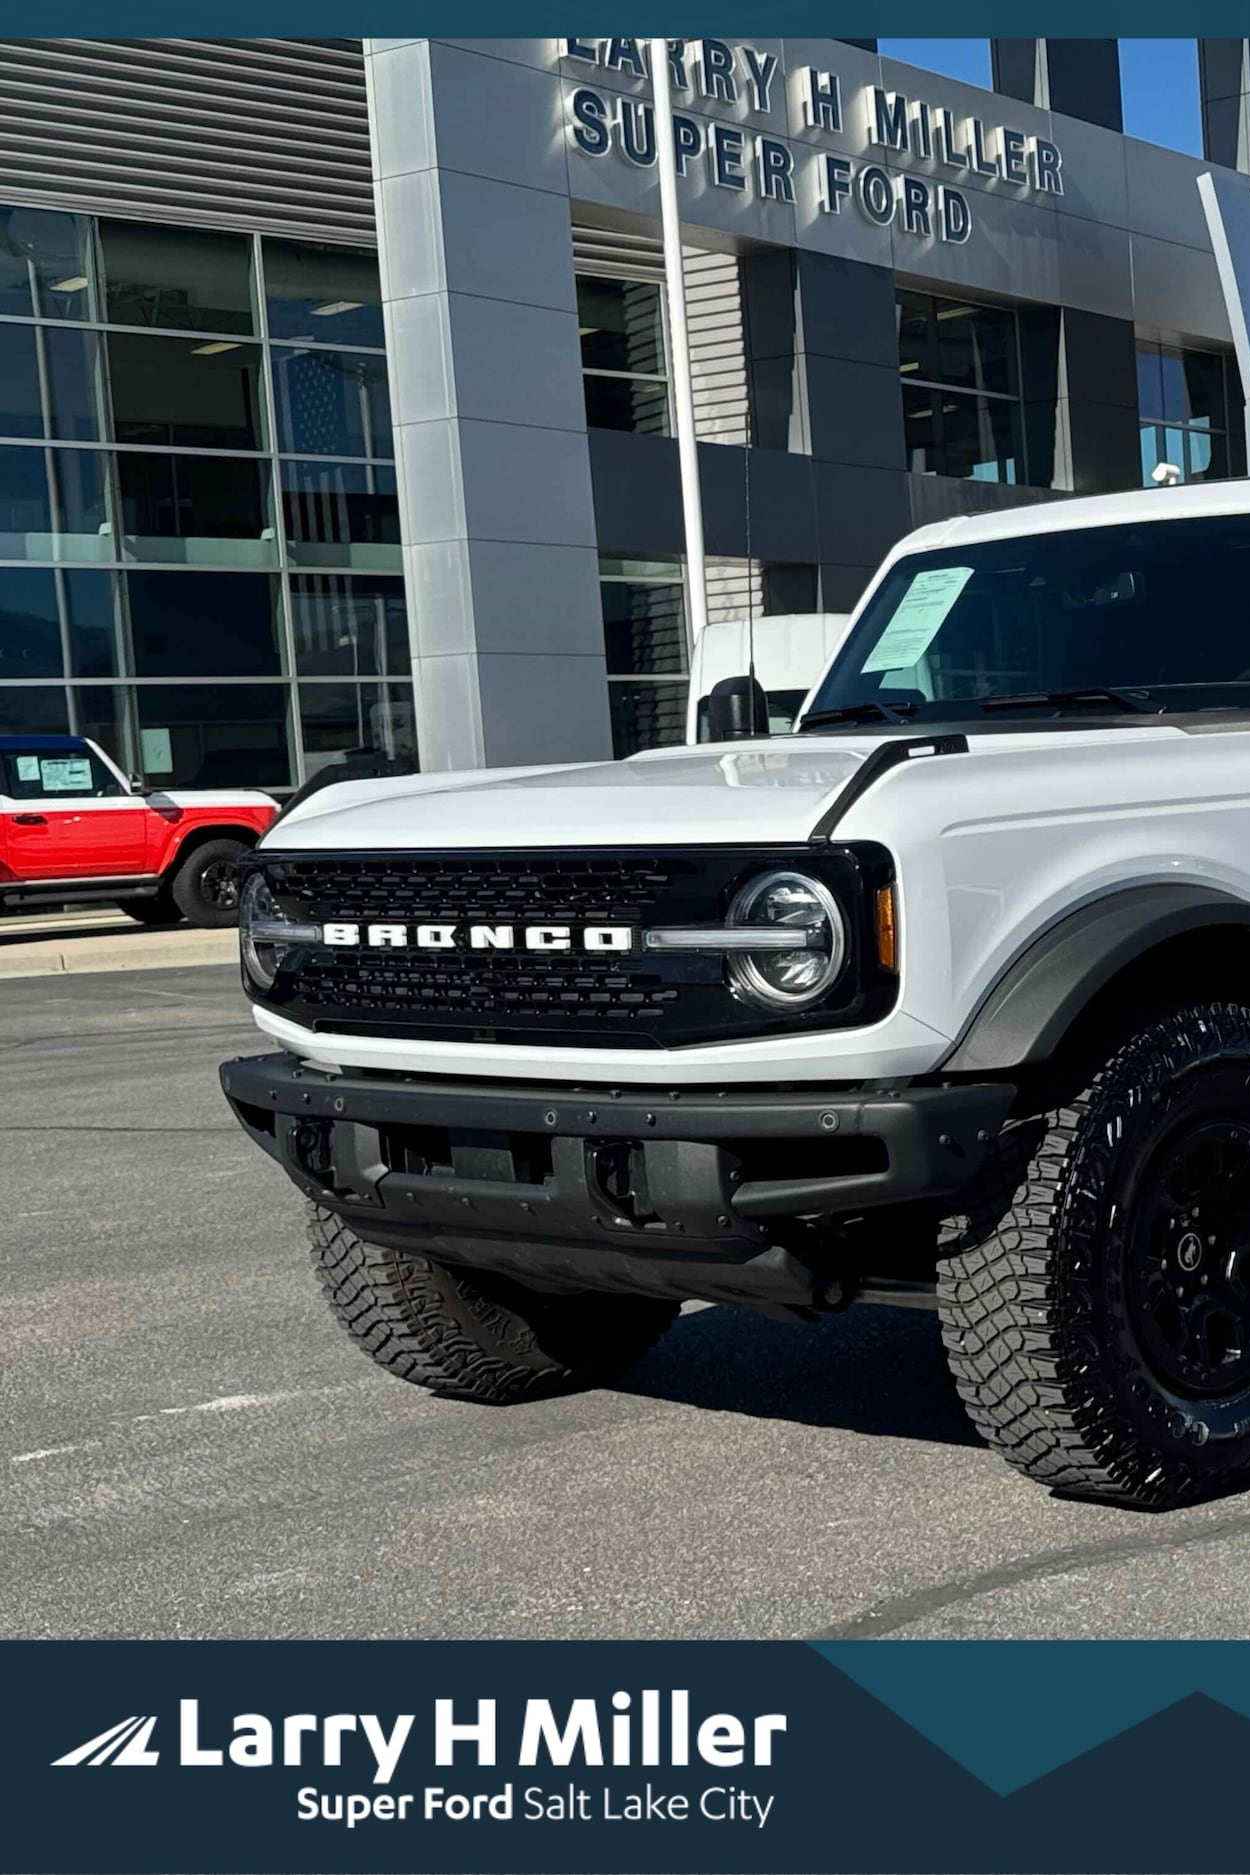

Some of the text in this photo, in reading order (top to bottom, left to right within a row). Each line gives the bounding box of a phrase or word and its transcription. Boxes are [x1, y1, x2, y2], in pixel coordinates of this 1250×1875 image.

[565, 87, 972, 245] SUPER FORD
[800, 65, 843, 133] H
[865, 84, 1065, 196] MILLER
[323, 923, 632, 951] BRONCO
